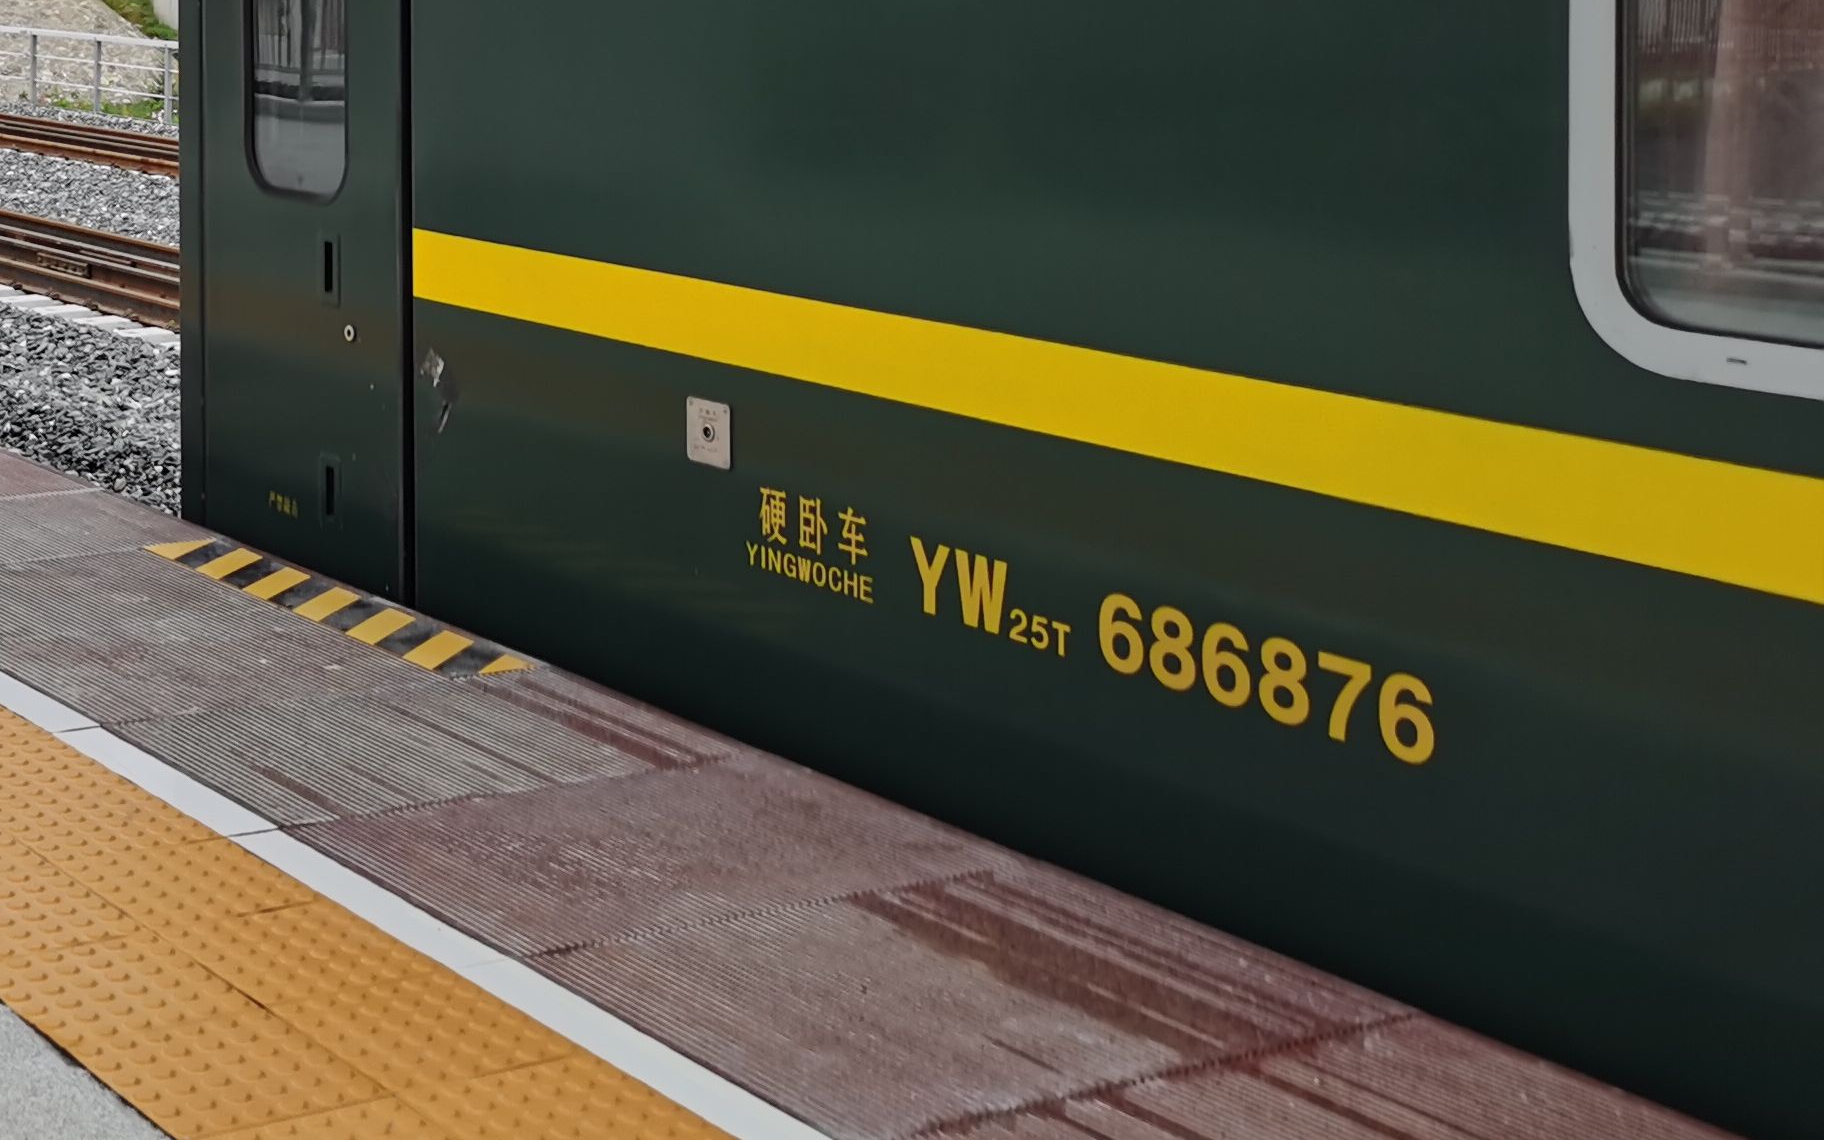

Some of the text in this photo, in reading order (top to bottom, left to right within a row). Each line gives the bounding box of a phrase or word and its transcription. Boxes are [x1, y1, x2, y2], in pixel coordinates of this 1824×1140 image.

[759, 486, 869, 566] 硬卧车
[745, 539, 875, 604] YINGWOCHE
[1097, 592, 1436, 765] 686876
